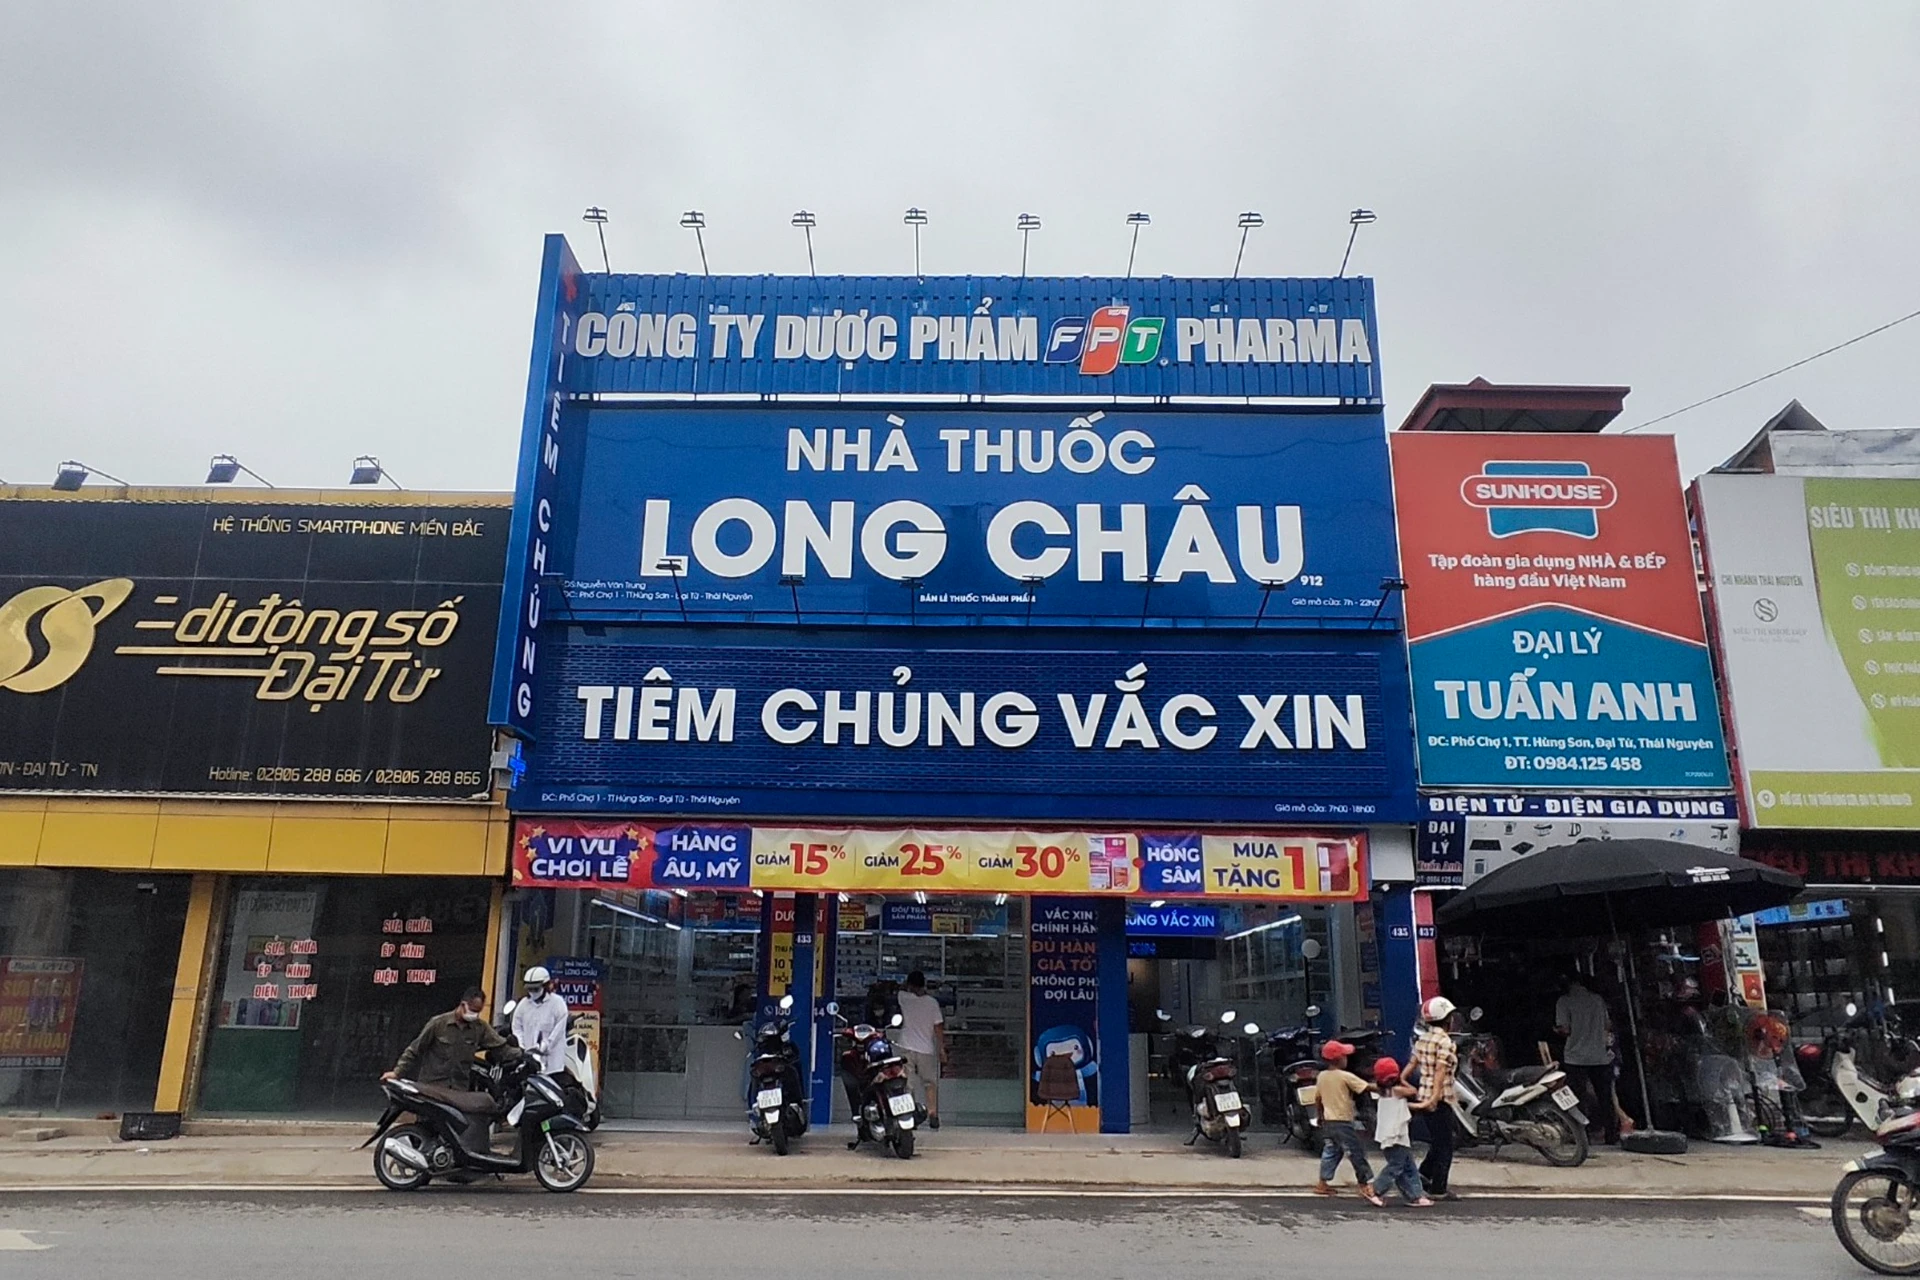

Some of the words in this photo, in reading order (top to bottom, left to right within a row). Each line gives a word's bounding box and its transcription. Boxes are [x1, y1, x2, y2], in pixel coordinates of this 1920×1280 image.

[575, 302, 697, 359] CÔNG
[708, 313, 765, 359] TY
[774, 309, 897, 370] DƯỢC
[909, 297, 1038, 361] PHẨM
[1176, 317, 1372, 364] PHARMA
[786, 413, 919, 472] NHÀ
[939, 411, 1156, 475] THUỐC
[1476, 484, 1602, 499] SUNHOUSE
[213, 515, 234, 535] HỆ
[240, 514, 291, 533] THỐNG
[297, 519, 405, 536] SMARTPHONE
[452, 517, 484, 536] BẮC
[1810, 502, 1854, 528] SIÊU
[1859, 507, 1891, 533] THỊ
[640, 497, 948, 581] LONG
[986, 484, 1304, 585] CHÂU
[1428, 554, 1458, 570] Tập
[1461, 554, 1502, 568] đoàn
[1505, 555, 1530, 572] gia
[1533, 554, 1575, 572] dụng
[1578, 553, 1616, 569] NHÀ
[1619, 557, 1631, 569] &
[1635, 552, 1666, 569] BẾP
[1300, 575, 1323, 587] 912
[1474, 573, 1515, 589] hàng
[1519, 573, 1549, 587] đầu
[1552, 574, 1586, 590] Việt
[1589, 575, 1627, 588] Nam
[1513, 630, 1563, 659] ĐẠI
[1571, 627, 1602, 655] LÝ
[1434, 668, 1577, 720] TUẤN
[1587, 682, 1697, 721] ANH
[577, 666, 736, 742] TIÊM
[761, 665, 1039, 748] CHỦNG
[1057, 662, 1218, 750] VẮC
[1237, 694, 1366, 750] XIN
[1428, 736, 1449, 747] ĐC:
[1451, 735, 1475, 747] Phố
[1477, 736, 1500, 749] Chợ
[1638, 738, 1664, 749] Thái
[1667, 738, 1713, 751] Nguyên
[80, 763, 98, 777] TN
[1505, 756, 1531, 770] ĐT:
[1534, 757, 1608, 770] 0984.125
[1611, 757, 1642, 771] 458
[209, 766, 252, 781] Hotline:
[257, 767, 300, 782] 02806
[303, 767, 331, 783] 288
[335, 767, 362, 783] 686
[375, 770, 420, 784] 02806
[423, 770, 451, 785] 288
[454, 771, 481, 785] 866
[1429, 797, 1488, 816] ĐIỆN
[1493, 794, 1524, 814] TỬ
[1545, 797, 1604, 817] ĐIỆN
[1610, 799, 1655, 815] GIA
[1658, 799, 1725, 818] DỤNG
[1428, 821, 1455, 836] ĐẠI
[548, 837, 572, 854] VI
[580, 838, 615, 855] VU
[671, 832, 737, 852] HÀNG
[1233, 842, 1278, 859] MUA
[1431, 839, 1450, 854] LÝ
[755, 851, 790, 866] GIẢM
[790, 843, 846, 875] 15%
[864, 852, 899, 867] GIẢM
[899, 844, 962, 876] 25%
[979, 853, 1013, 868] GIẢM
[1015, 845, 1080, 878] 30%
[1147, 842, 1200, 863] HỒNG
[531, 858, 591, 877] CHƠI
[600, 855, 629, 878] LỄ
[662, 857, 701, 881] ÂU,
[706, 857, 742, 879] MỸ
[1161, 867, 1201, 884] SÂM
[1284, 846, 1305, 890] 1
[1213, 863, 1280, 892] TẶNG
[1045, 906, 1069, 920] VẮC
[1072, 911, 1093, 920] XIN
[1160, 909, 1190, 927] VẮC
[1193, 915, 1215, 927] XIN
[1032, 921, 1069, 933] CHÍNH
[1072, 922, 1097, 933] HÃN
[381, 942, 396, 958] ÉP
[400, 942, 425, 958] KÍNH
[1031, 936, 1055, 953] ĐỦ
[1060, 938, 1096, 953] HÀN
[257, 961, 272, 978] ÉP
[285, 961, 311, 978] KÍNH
[406, 969, 436, 986] THOẠI
[560, 984, 570, 992] VI
[1031, 973, 1075, 986] KHÔNG
[288, 984, 318, 1000] THOẠI
